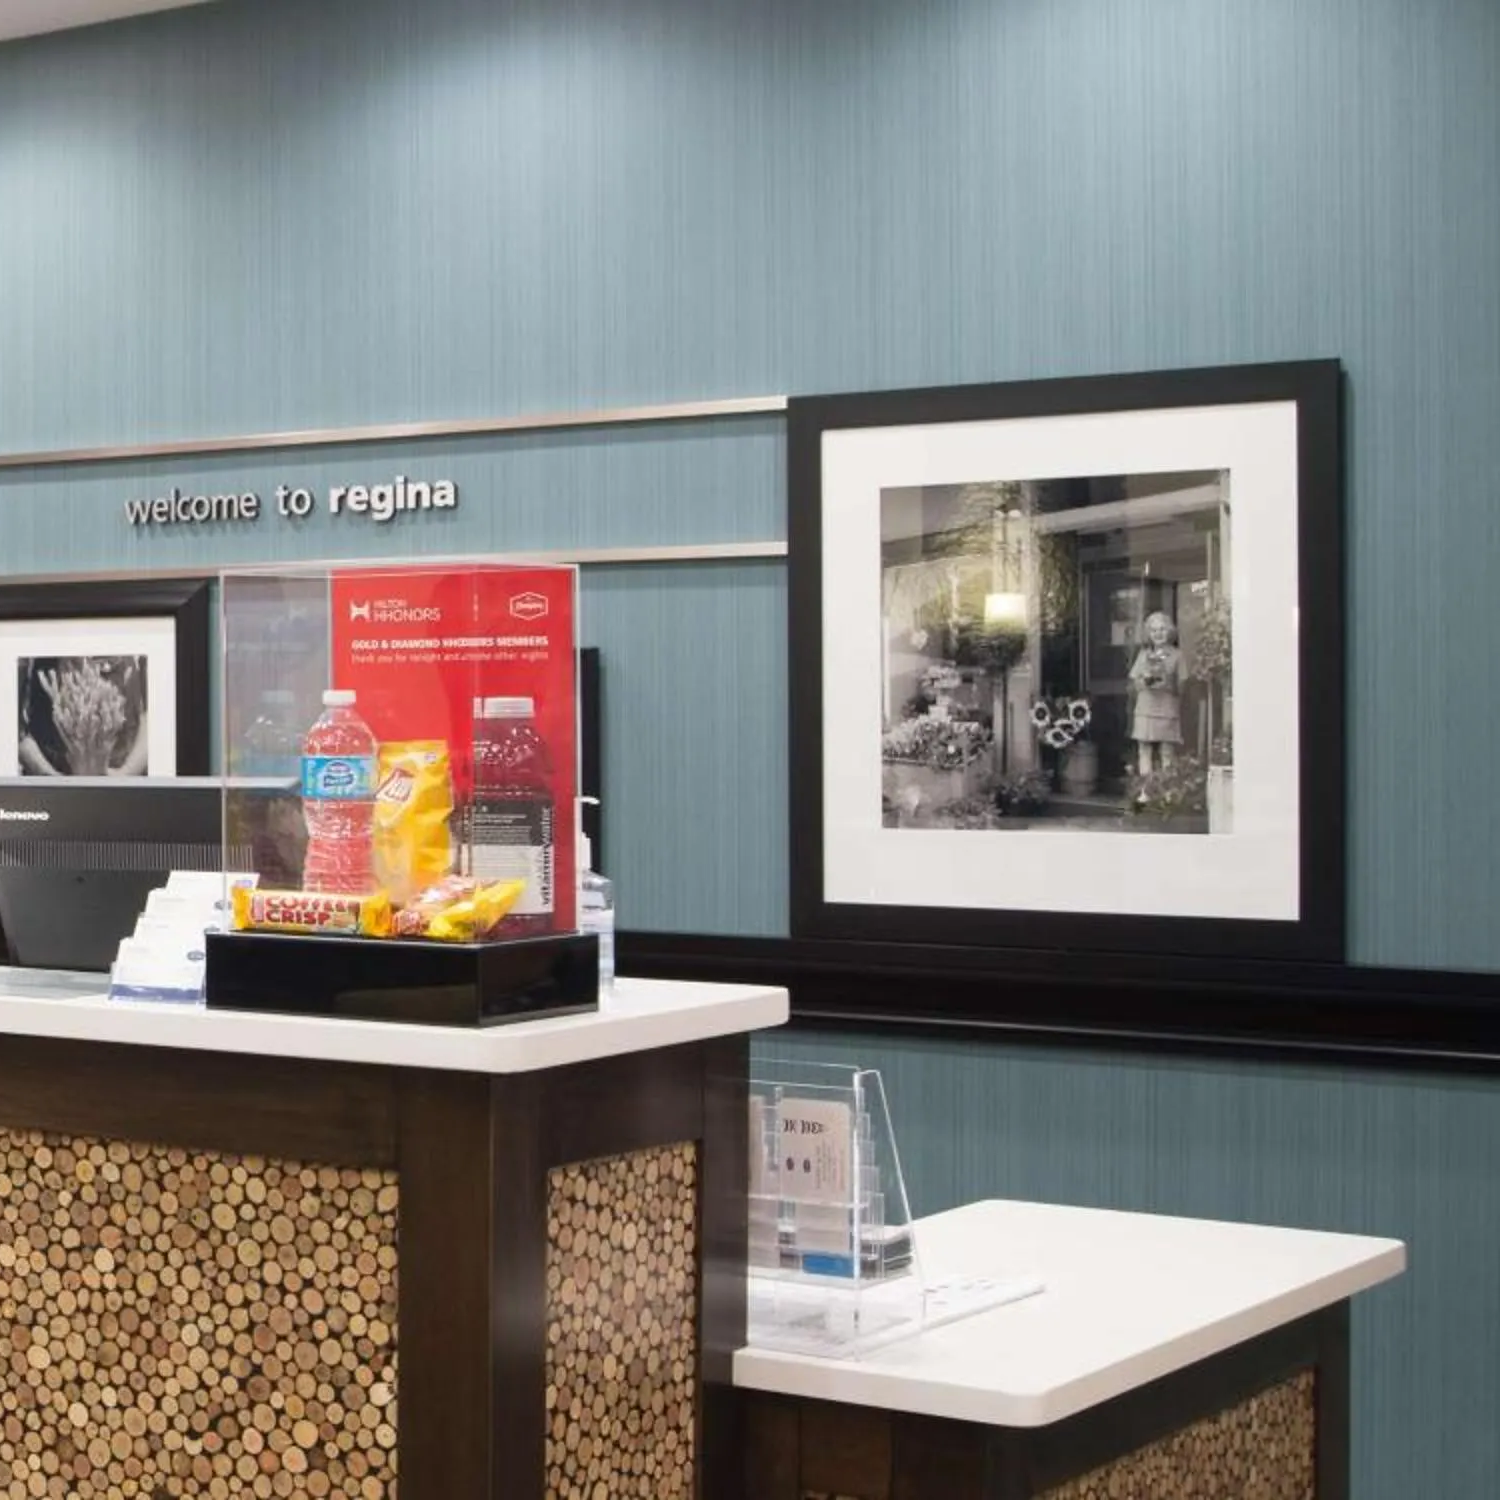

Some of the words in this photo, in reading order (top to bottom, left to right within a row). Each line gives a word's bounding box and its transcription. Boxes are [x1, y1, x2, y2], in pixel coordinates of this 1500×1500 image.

[123, 488, 259, 525] welcome
[276, 485, 314, 516] to
[330, 476, 458, 521] regina
[373, 599, 408, 609] HILTON
[373, 607, 441, 622] HHONORS
[352, 639, 378, 650] GOLD
[380, 639, 390, 649] &
[391, 638, 439, 649] DIAMOND
[497, 635, 548, 647] MEMBERS
[0, 808, 49, 821] lenovo
[265, 909, 331, 925] CRISP
